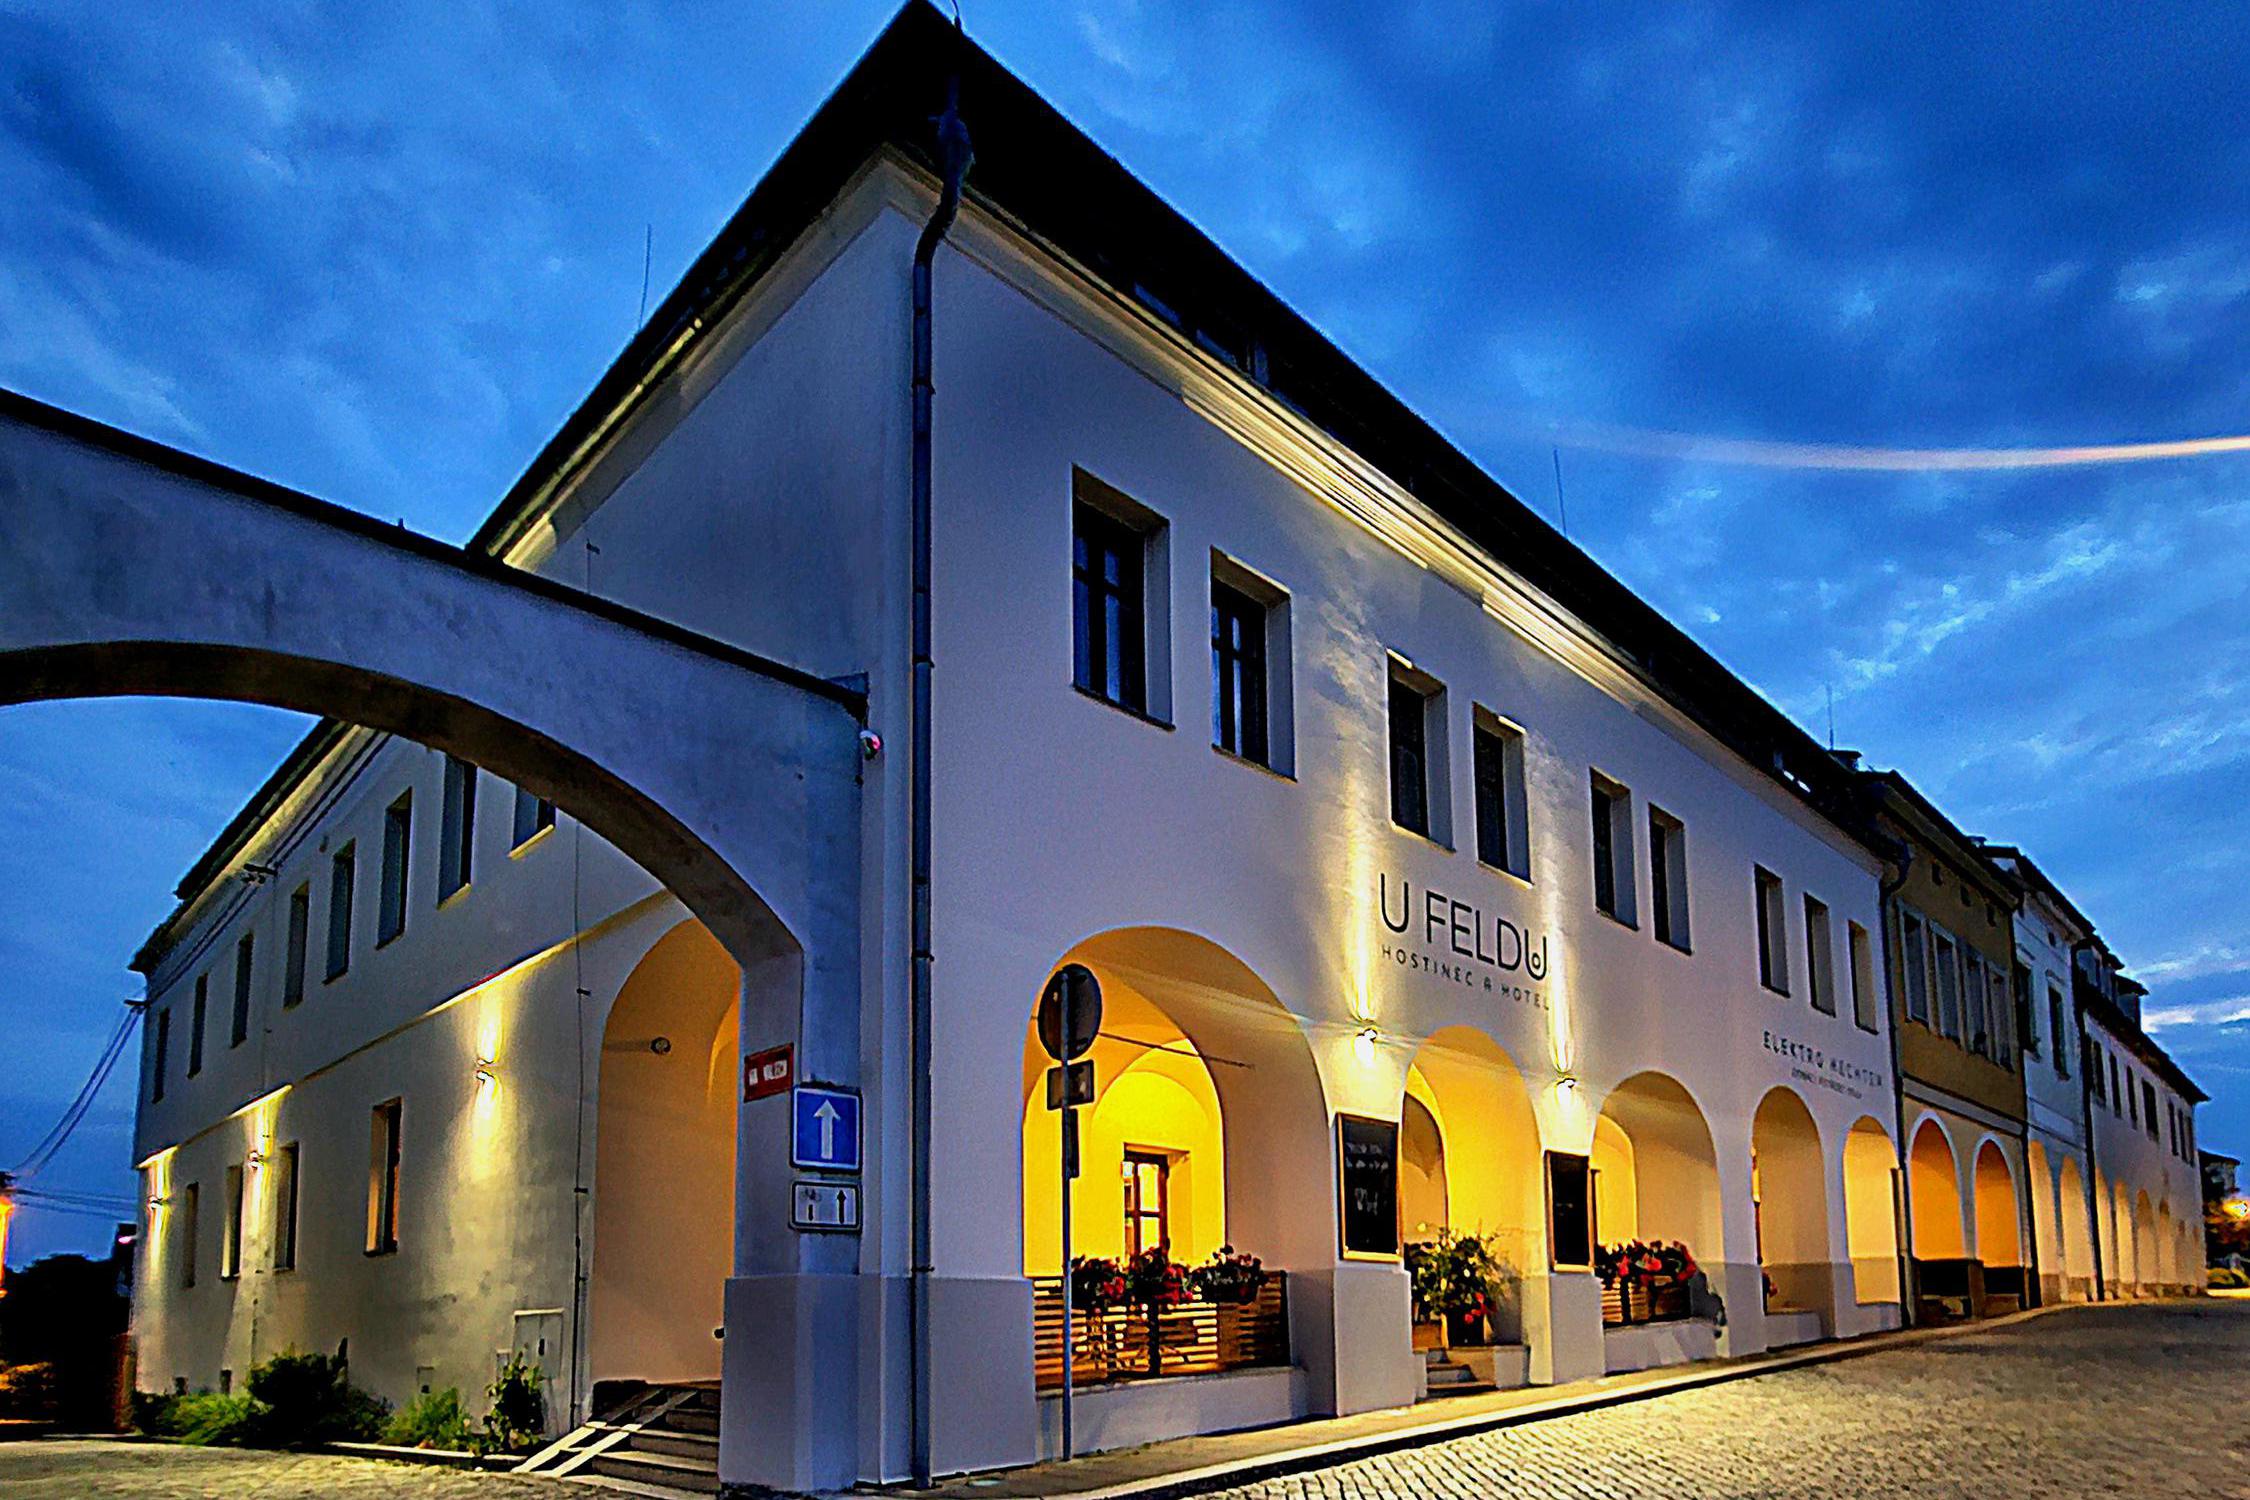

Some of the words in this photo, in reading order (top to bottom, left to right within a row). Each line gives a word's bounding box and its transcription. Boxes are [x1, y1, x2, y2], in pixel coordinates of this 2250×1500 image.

[1380, 872, 1409, 933] U
[1381, 944, 1474, 988] HOSTINEC
[1500, 983, 1550, 1011] HOTEL
[1763, 1030, 1824, 1069] ELEKTRO
